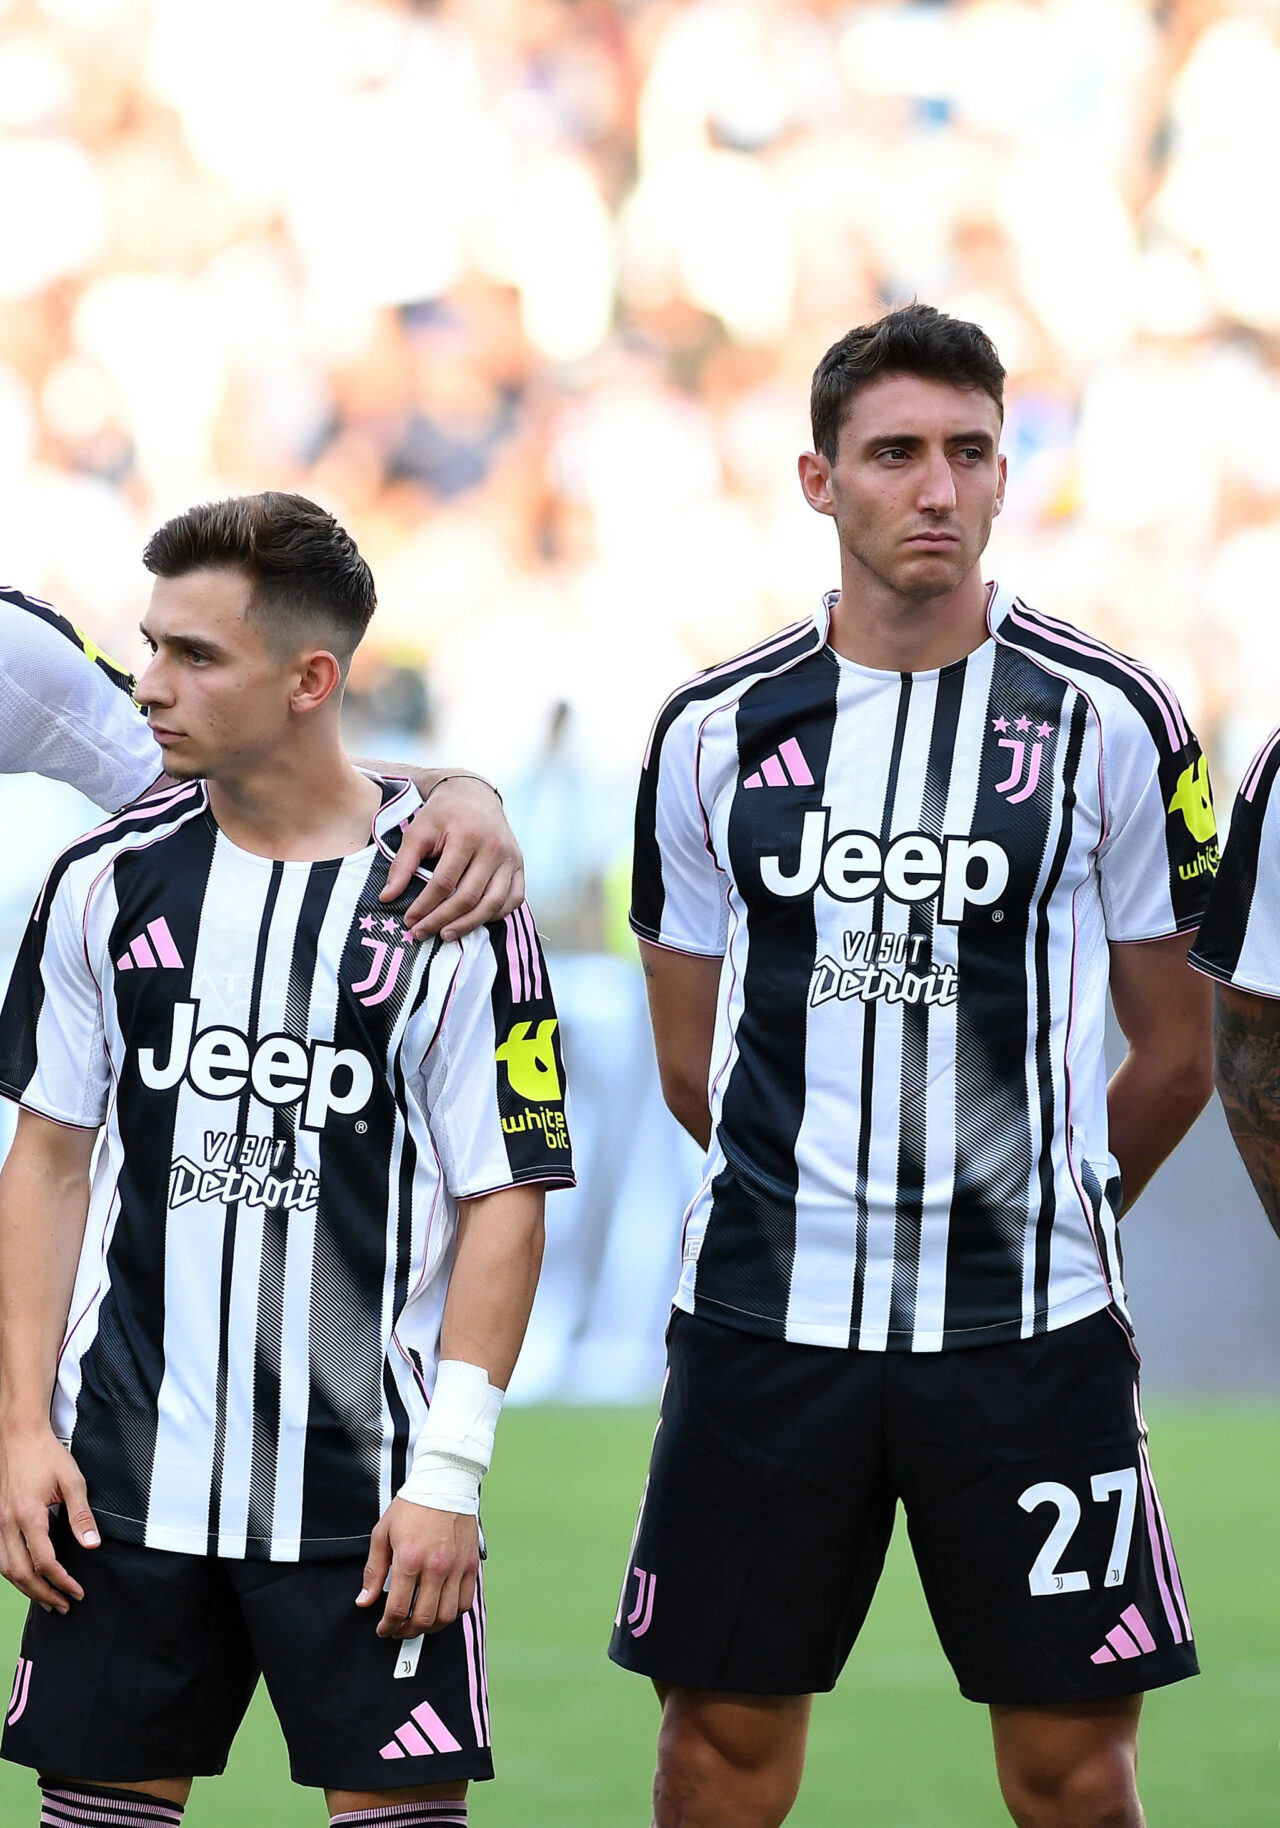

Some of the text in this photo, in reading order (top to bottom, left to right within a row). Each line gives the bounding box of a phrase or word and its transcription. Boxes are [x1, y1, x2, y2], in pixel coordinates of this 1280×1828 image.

[759, 811, 1010, 922] Jeep
[843, 930, 926, 965] VISIT
[810, 955, 959, 1008] Detroit
[137, 1002, 374, 1129] Jeep
[501, 1106, 566, 1134] white
[545, 1127, 569, 1149] bit
[204, 1130, 287, 1168] VISIT
[169, 1155, 320, 1211] Detroit
[1018, 1467, 1138, 1596] 27
